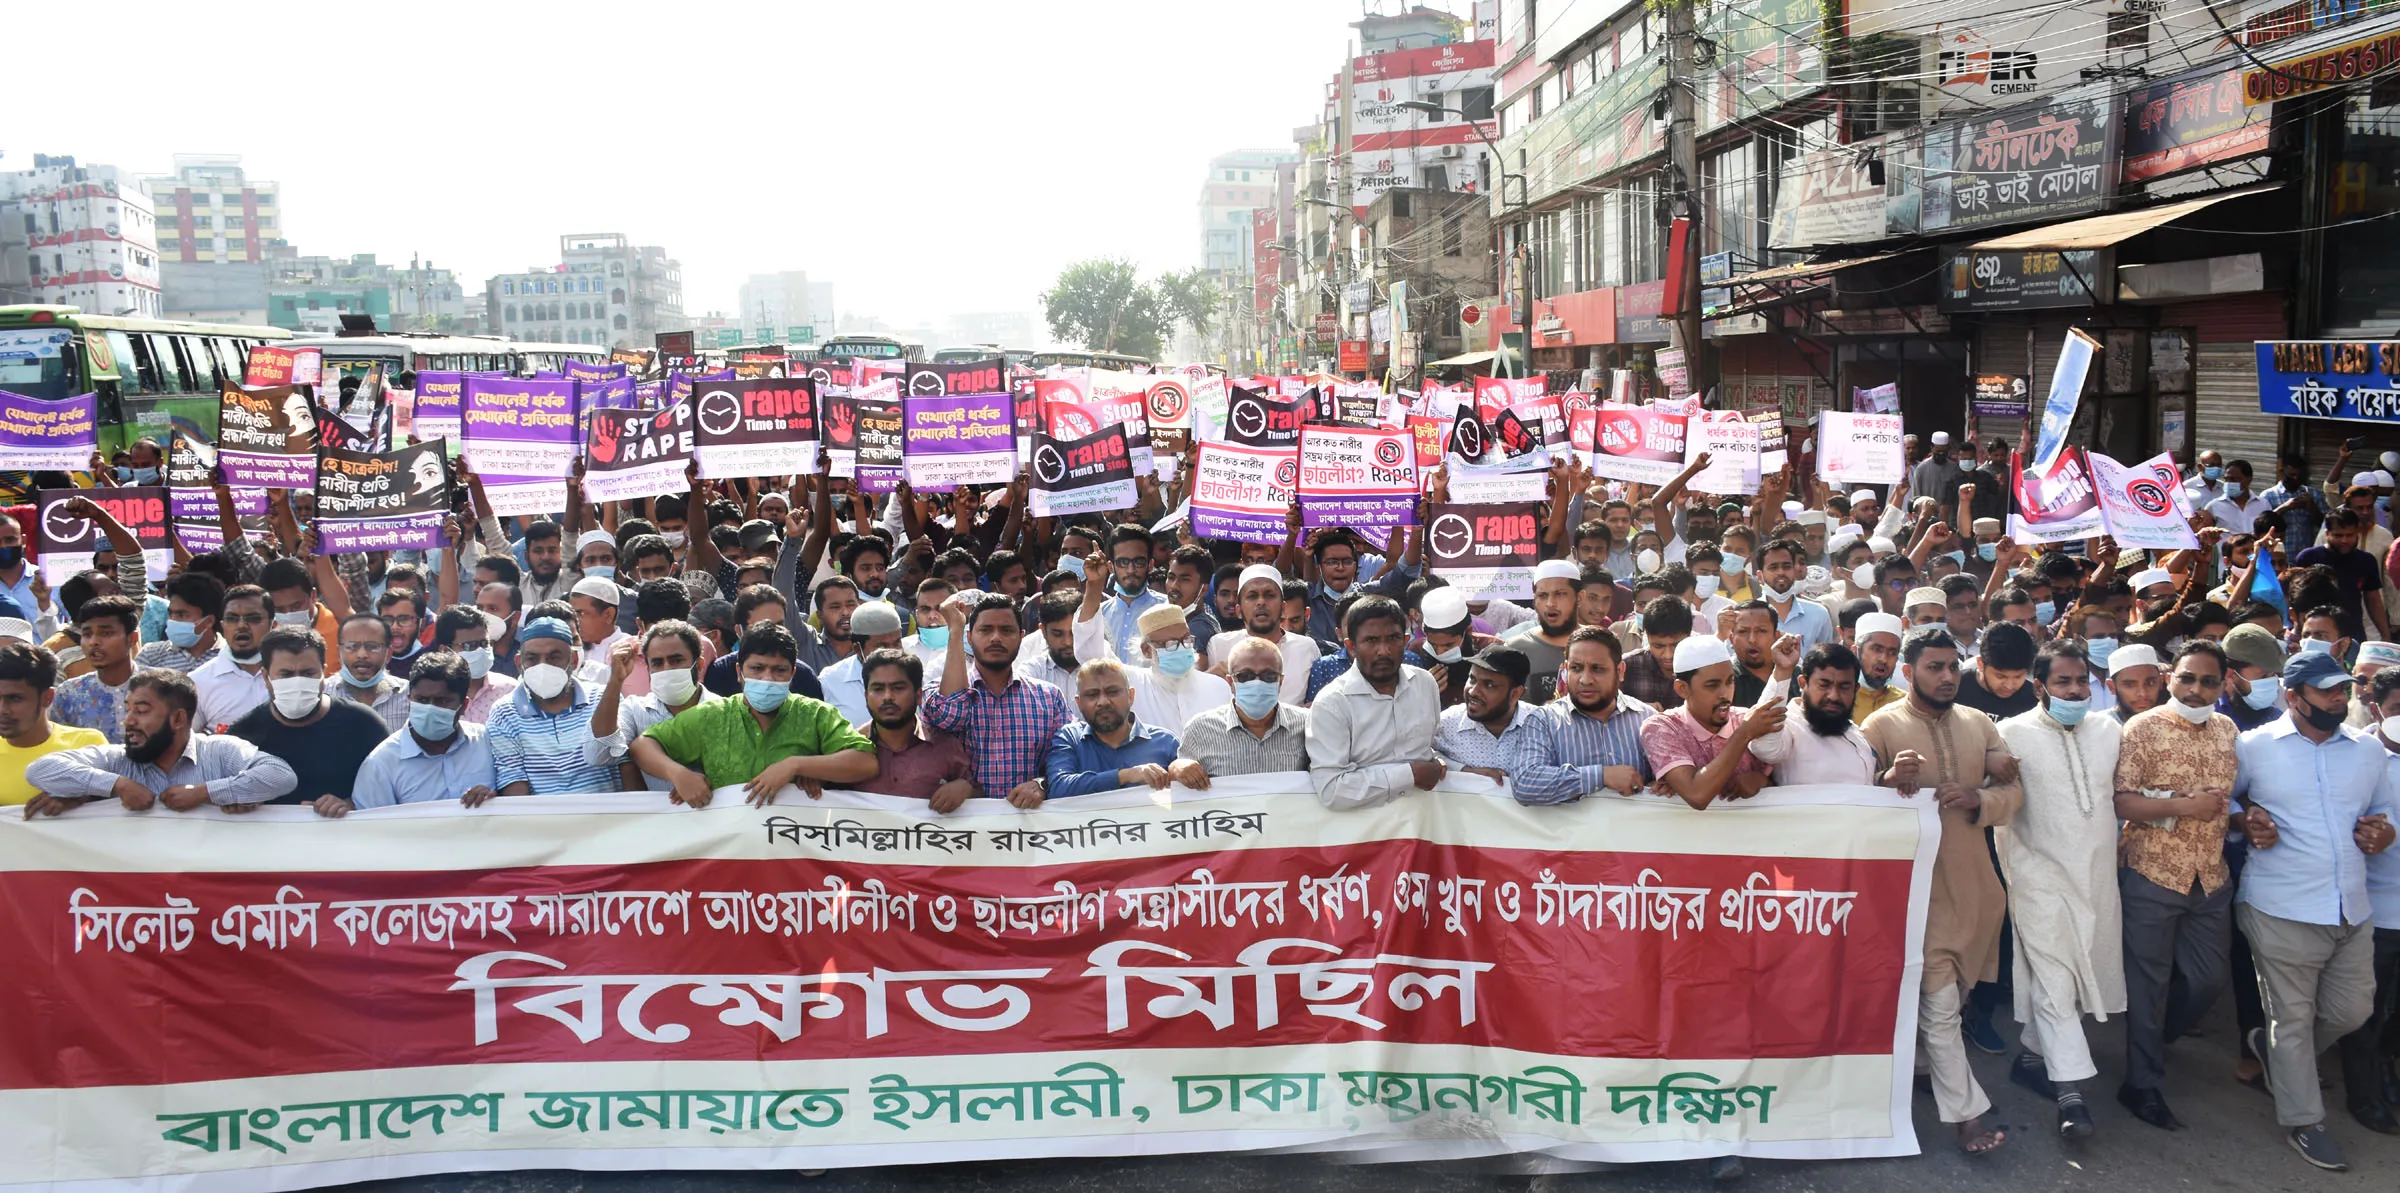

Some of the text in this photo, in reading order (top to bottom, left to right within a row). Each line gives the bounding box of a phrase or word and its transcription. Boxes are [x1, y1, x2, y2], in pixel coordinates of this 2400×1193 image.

[1355, 67, 1387, 77] METROCM
[1991, 83, 2038, 95] CEMENT
[1956, 179, 1992, 211] ভাই
[1994, 172, 2033, 203] ভাই
[2038, 162, 2101, 199] মেটাল
[1975, 255, 2001, 286] asp
[2331, 343, 2369, 374] LED
[947, 368, 1000, 393] rape
[1516, 382, 1544, 397] Stop
[2288, 377, 2339, 416] বাইক
[475, 391, 566, 408] যেখানেই ধর্ষক
[743, 388, 811, 418] rape
[5, 407, 86, 424] যেখানেই ধর্ষক
[465, 409, 575, 428] সেখানেই প্রতিরোধ
[916, 404, 1000, 424] যেখানেই ধর্ষক
[1102, 401, 1143, 422] Stop
[1524, 403, 1561, 420] Stop
[624, 403, 692, 438] STOP
[744, 417, 813, 431] Time to stop
[861, 418, 873, 429] হে
[1649, 417, 1684, 437] Stop
[1852, 417, 1900, 429] ধর্ষক হটাও
[268, 432, 286, 447] হও!
[860, 429, 888, 445] নারীর
[907, 422, 1011, 441] সেখানেই প্রতিরোধ
[1267, 430, 1291, 440] Time
[1707, 427, 1757, 438] ধর্ষক হটাও
[1852, 431, 1900, 444] দেশ বাঁচাও
[622, 430, 694, 463] RAPE
[1067, 434, 1125, 469] rape
[1305, 437, 1362, 449] আর কত নারীর
[1645, 433, 1684, 454] Rape
[1708, 440, 1757, 453] দেশ বাঁচাও
[321, 456, 399, 476] হে ছাত্রলীগ!
[1094, 463, 1105, 473] to
[1106, 459, 1128, 471] stop
[1205, 453, 1265, 470] আর কত নারীর
[1324, 451, 1337, 464] লুট
[1338, 454, 1362, 463] করবে
[1223, 468, 1262, 482] লুট করবে
[1303, 462, 1365, 485] ছাত্রলীগ?
[1371, 466, 1413, 485] Rape
[320, 475, 391, 494] নারীর প্রতি
[1201, 480, 1262, 502] ছাত্রলীগ?
[317, 492, 406, 512] শ্রদ্ধাশীল হও!
[1303, 498, 1414, 511] বাংলাদেশ জামায়াতে ইসলামী
[1197, 514, 1233, 525] বাংলাদেশ
[1318, 512, 1400, 524] ঢাকা মহানগরী দক্ষিণ
[138, 526, 166, 538] stop
[317, 522, 360, 534] বাংলাদেশ
[1210, 528, 1228, 538] ঢাকা
[1230, 530, 1264, 541] মহানগরী
[1475, 514, 1537, 543] rape
[334, 532, 428, 548] ঢাকা মহানগরী দক্ষিণ
[1474, 543, 1537, 556] Time to stop
[989, 818, 1151, 852] রাহমানির
[1163, 810, 1270, 839] রাহিম
[67, 886, 200, 953] সিলেট
[211, 884, 321, 952] এমসি
[329, 895, 519, 950] কলেজসহ
[524, 890, 692, 938] সারাদেশে
[699, 875, 918, 937] আওয়ামীলীগ
[929, 894, 959, 933] ও
[967, 878, 1111, 938] ছাত্রলীগ
[1116, 867, 1289, 932] সন্ত্রাসীদের
[1298, 863, 1384, 931] ধর্ষণ,
[1436, 876, 1485, 937] খুন
[1494, 882, 1521, 924] ও
[1532, 867, 1710, 941] চাঁদাবাজির
[1718, 871, 1859, 937] প্রতিবাদে
[447, 936, 1496, 1046] বিক্ষোভ মিছিল
[156, 1060, 1778, 1155] বাংলাদেশ জামায়াতে ইসলামী, ঢাকা মহানগরী দক্ষিণ
